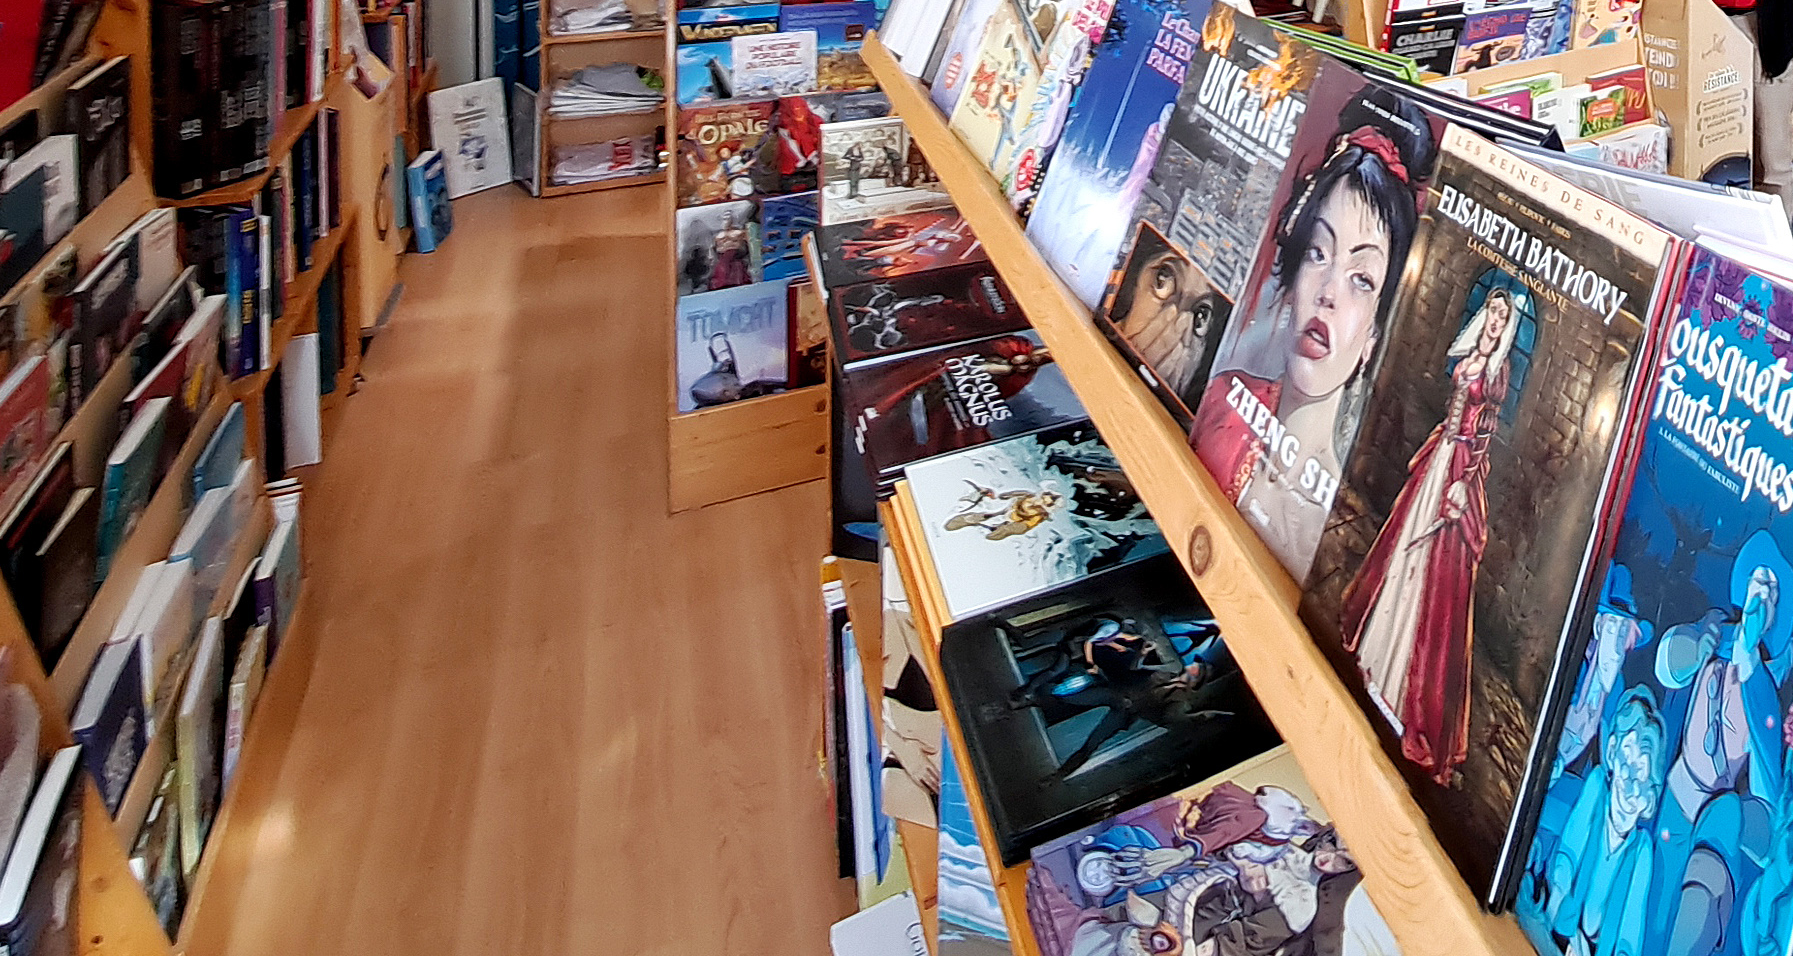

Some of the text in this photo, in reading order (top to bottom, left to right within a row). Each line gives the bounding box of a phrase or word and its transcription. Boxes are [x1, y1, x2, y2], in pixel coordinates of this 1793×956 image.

[1199, 53, 1307, 158] UKRAINE
[1455, 135, 1483, 156] LES
[1488, 151, 1550, 193] REINES
[1560, 190, 1583, 212] DE
[1594, 208, 1645, 246] SANG
[1436, 184, 1527, 265] ELISABETH
[1525, 236, 1629, 326] BATHORY
[1517, 270, 1571, 311] SANGLANTE
[1224, 376, 1301, 468] ZHENG
